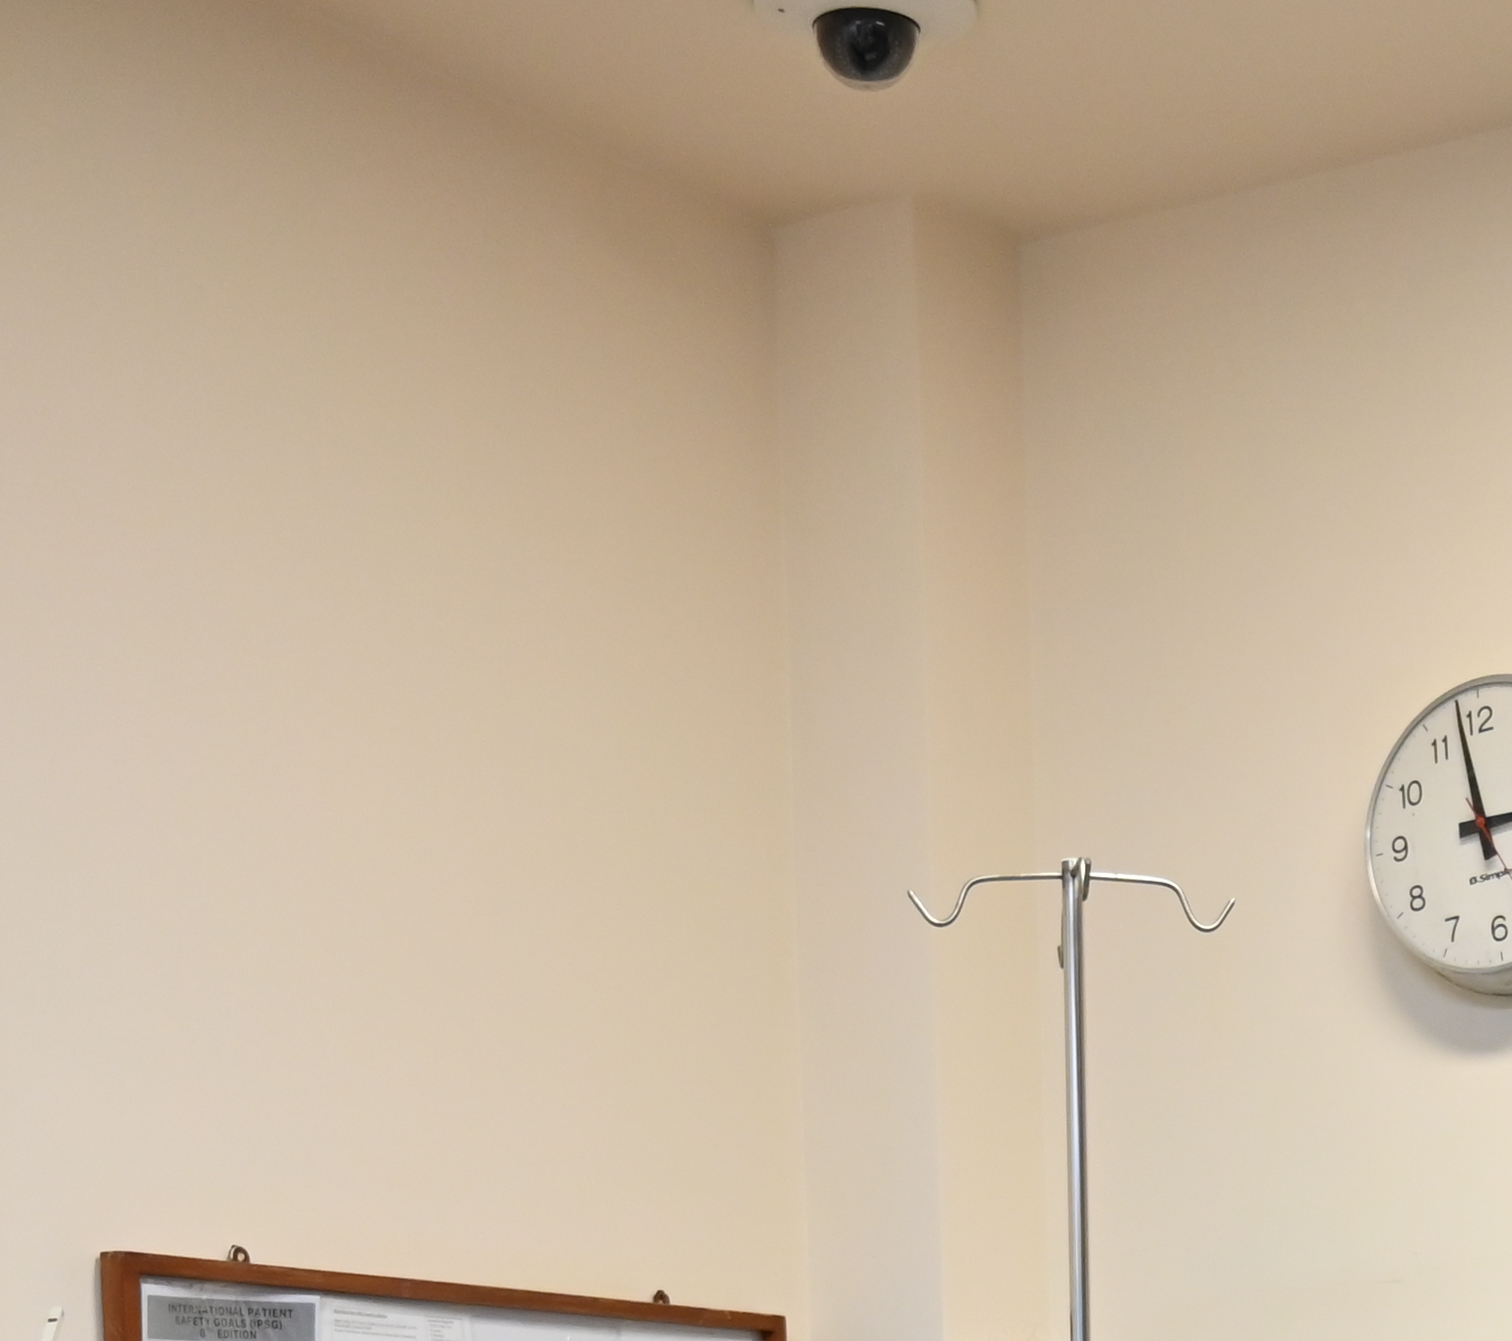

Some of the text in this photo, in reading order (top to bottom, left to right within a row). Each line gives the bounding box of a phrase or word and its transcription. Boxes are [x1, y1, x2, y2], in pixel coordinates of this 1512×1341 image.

[1465, 705, 1495, 736] 12
[1431, 735, 1450, 764] 11
[1399, 780, 1423, 808] 10
[1391, 836, 1409, 862] 9
[1410, 885, 1426, 912] 8
[1444, 915, 1461, 943] 7
[1491, 915, 1509, 942] 6
[168, 1303, 294, 1319] INTERNATIONAL PATIENT
[175, 1316, 283, 1330] SAFETY GOALS (IPSG)
[217, 1330, 257, 1339] EDITION
